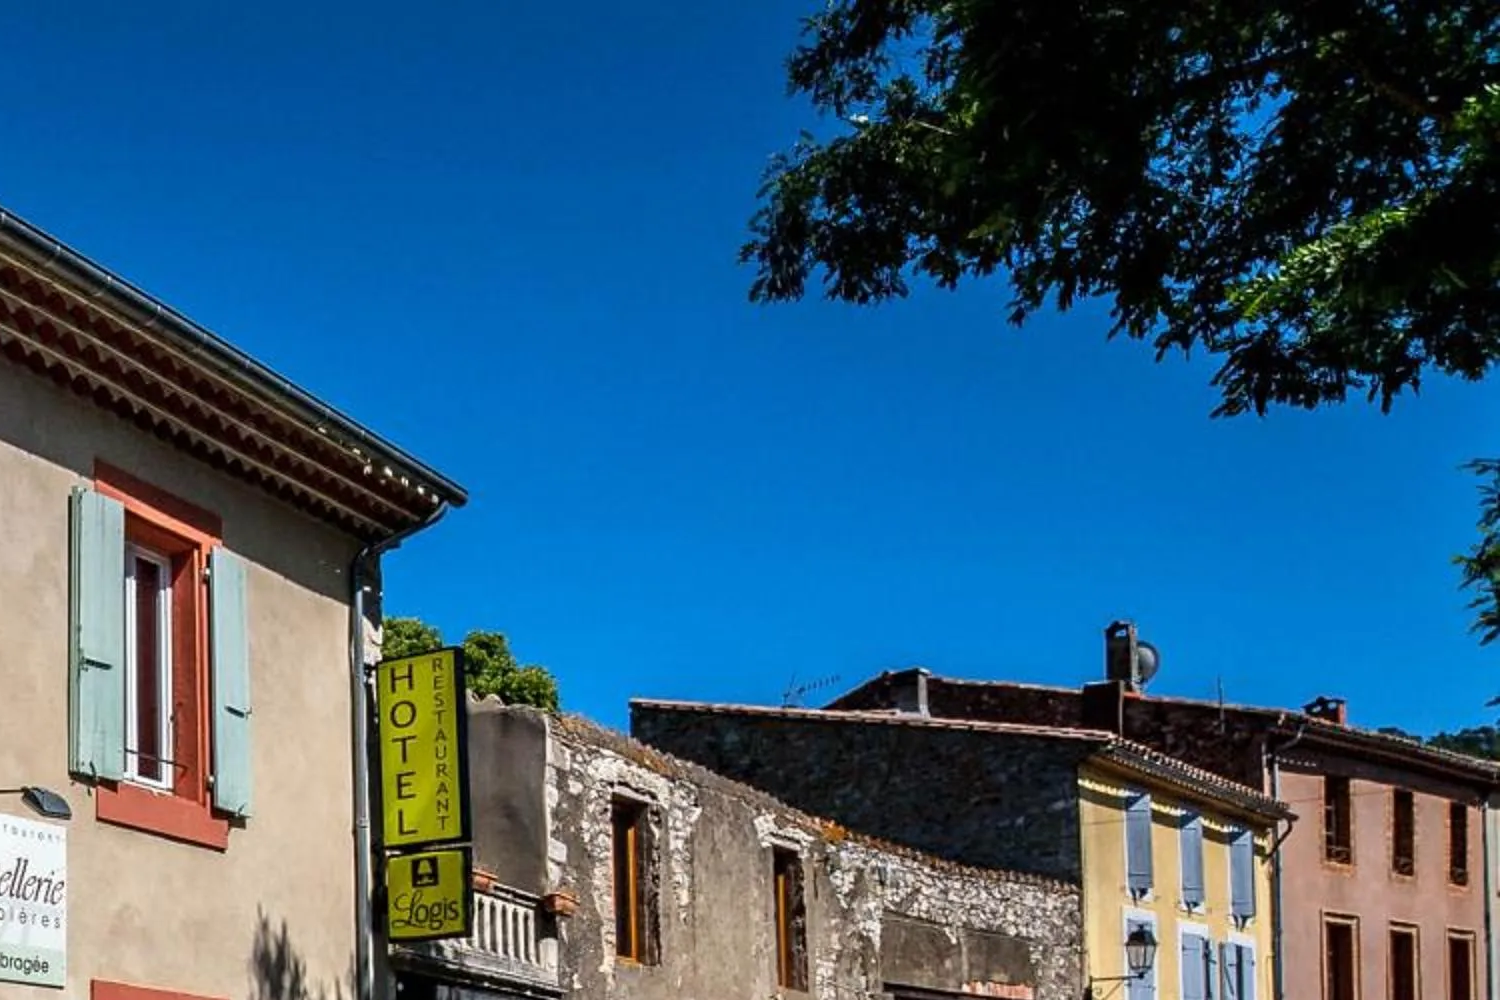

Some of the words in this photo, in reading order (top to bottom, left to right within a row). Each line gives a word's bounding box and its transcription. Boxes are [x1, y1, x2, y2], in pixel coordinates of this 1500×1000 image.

[389, 664, 418, 837] HOTEL
[431, 655, 451, 832] RESTAURANT
[391, 890, 460, 931] Logis
